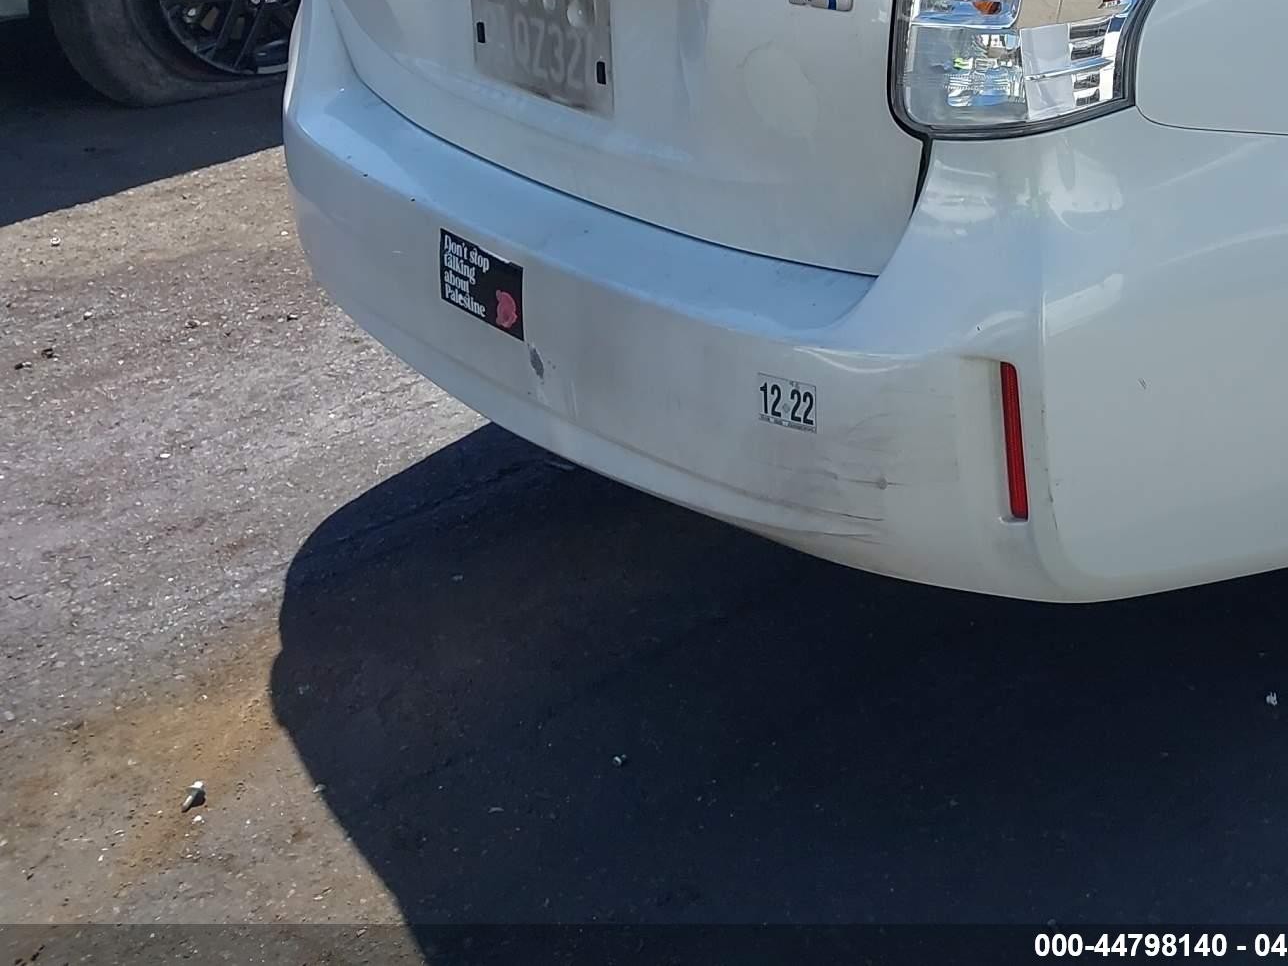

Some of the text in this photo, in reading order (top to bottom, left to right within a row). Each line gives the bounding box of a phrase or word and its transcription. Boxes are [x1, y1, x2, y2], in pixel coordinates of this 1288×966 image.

[444, 235, 490, 273] Don't stop
[444, 254, 476, 285] talking
[444, 271, 469, 293] about
[445, 283, 486, 317] Palestine
[760, 382, 781, 417] 12
[790, 389, 813, 426] 22
